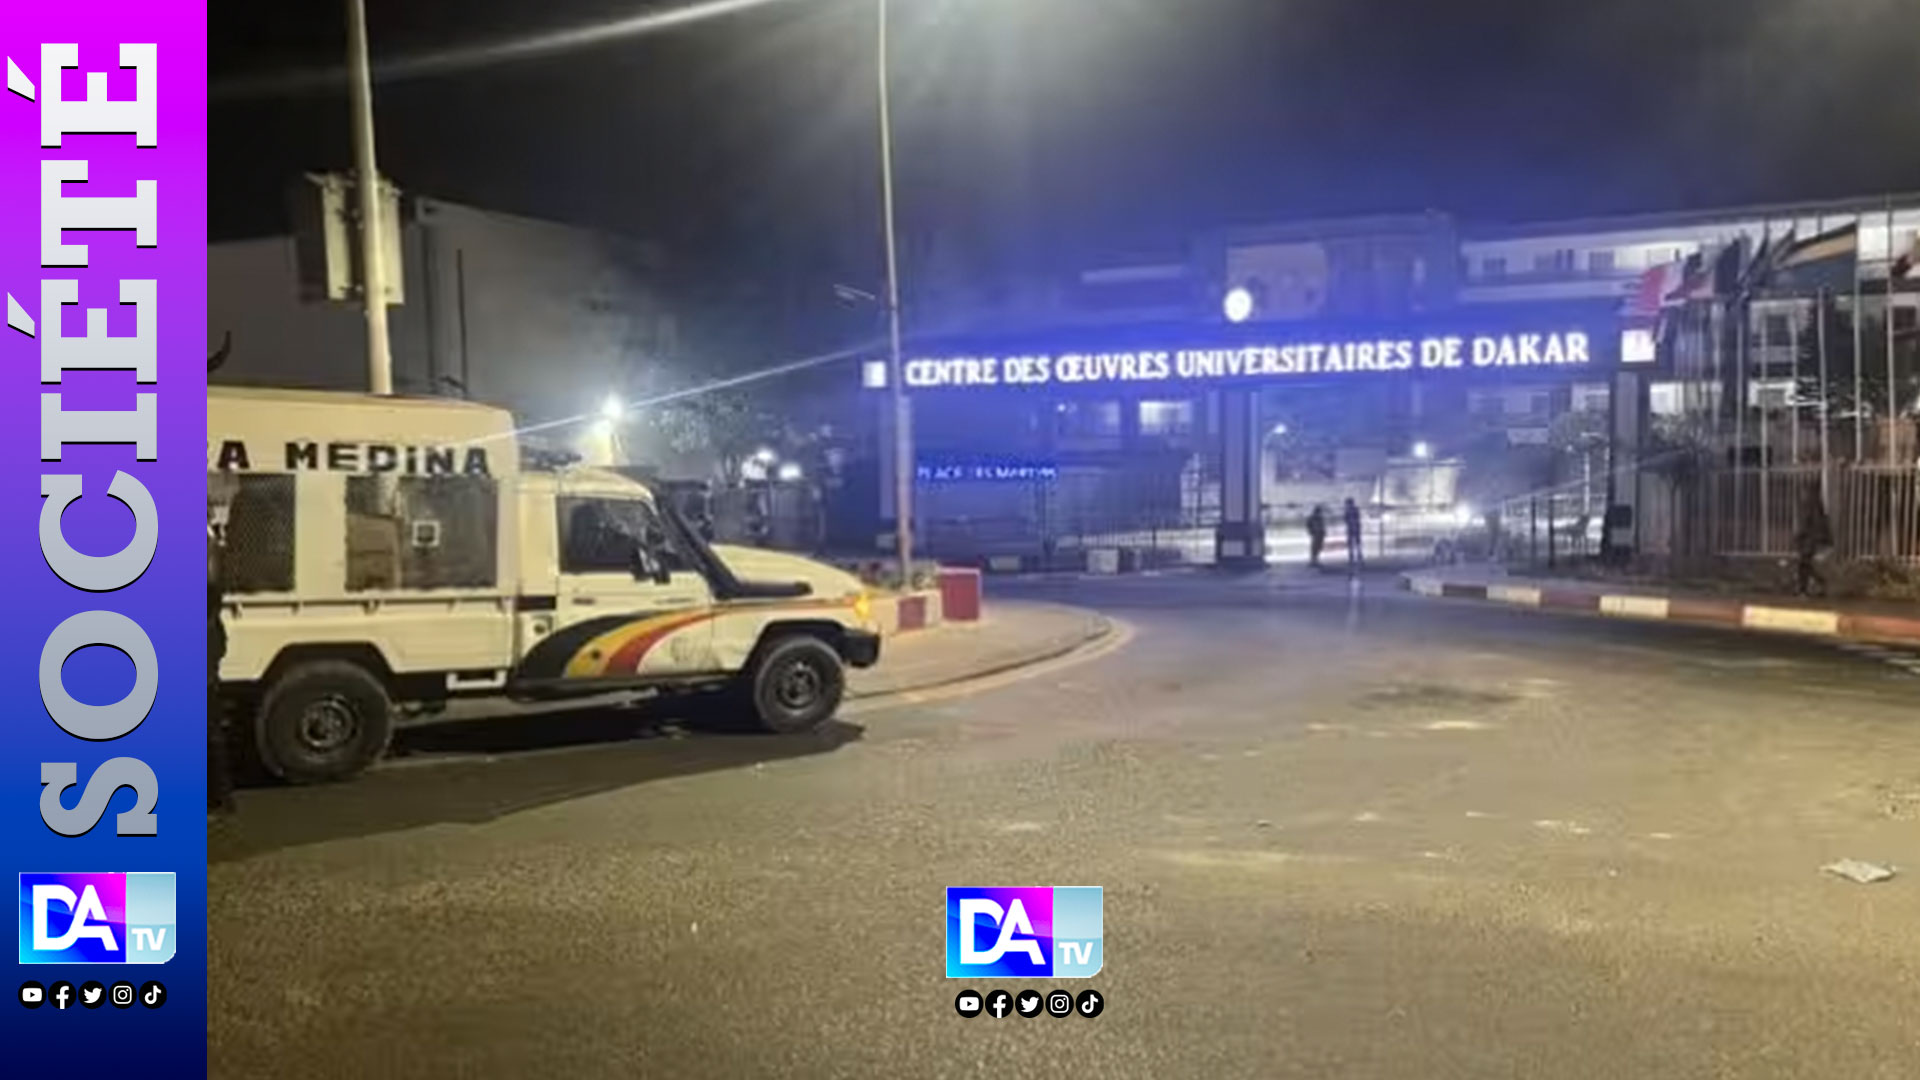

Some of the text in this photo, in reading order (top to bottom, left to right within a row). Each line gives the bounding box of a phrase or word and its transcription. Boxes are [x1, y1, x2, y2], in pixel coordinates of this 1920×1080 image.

[905, 332, 1590, 386] CENTRE DES ŒUVRES UNIVERSITAIRES DE DAKAR
[207, 440, 250, 469] A
